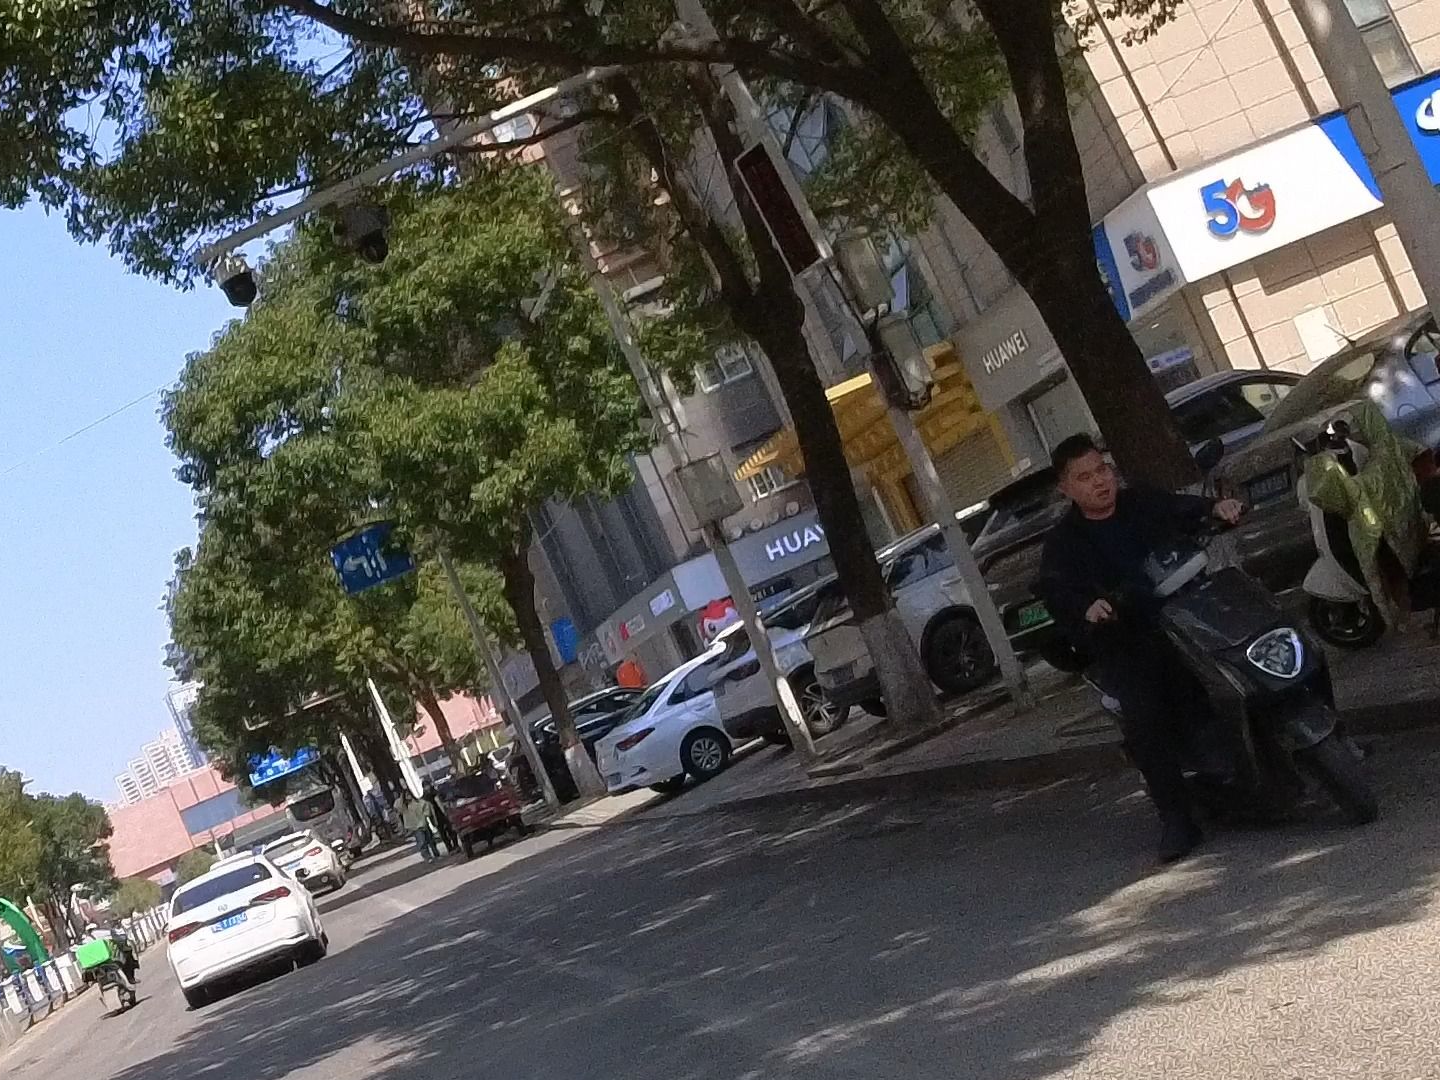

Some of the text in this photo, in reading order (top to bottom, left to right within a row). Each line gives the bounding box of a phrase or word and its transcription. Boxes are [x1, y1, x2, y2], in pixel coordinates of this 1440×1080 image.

[1199, 177, 1277, 236] 5G
[982, 328, 1030, 375] HUAWEI
[765, 524, 825, 561] HUA
